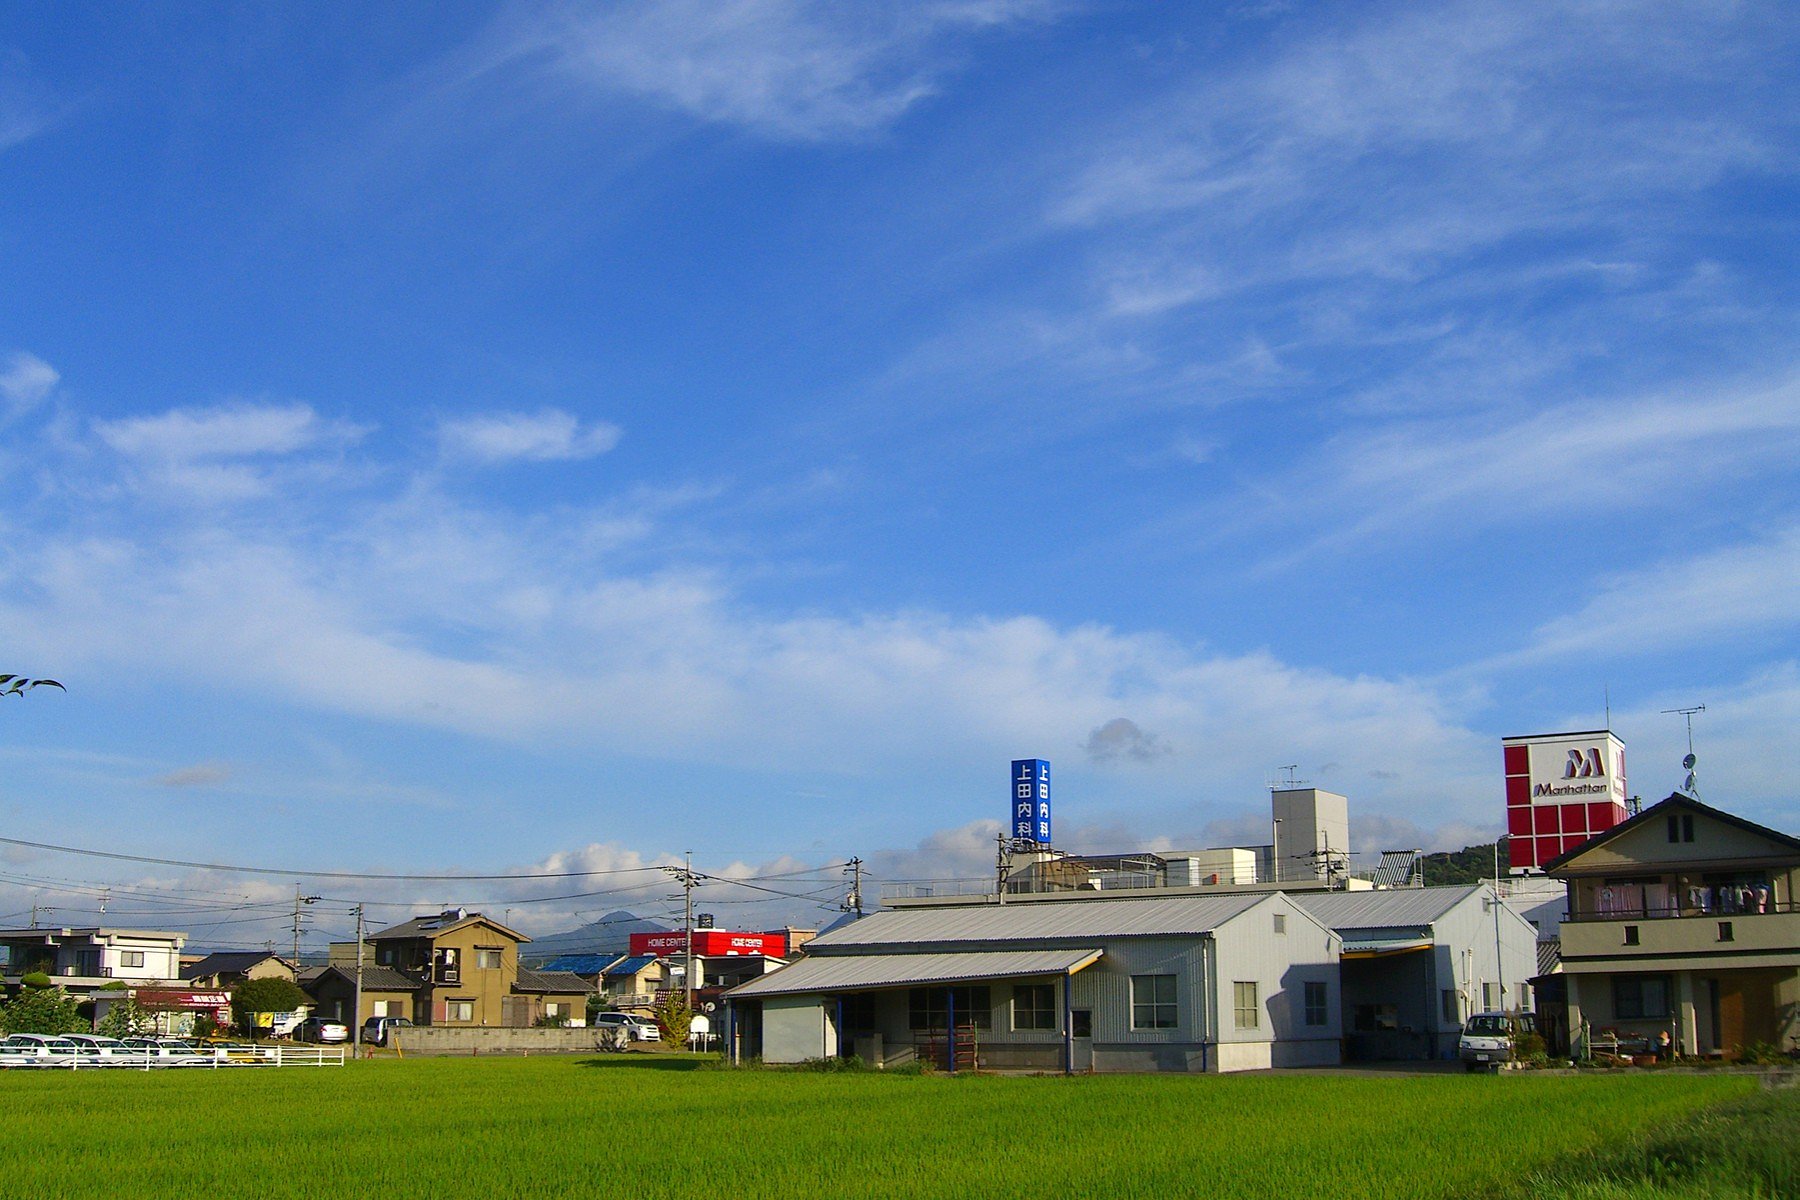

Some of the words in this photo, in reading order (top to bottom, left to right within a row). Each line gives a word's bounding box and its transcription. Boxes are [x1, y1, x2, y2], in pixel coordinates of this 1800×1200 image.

[1534, 783, 1607, 798] Manhattan
[1017, 764, 1032, 837] 上田内科
[1039, 764, 1049, 838] 上田内科
[648, 938, 666, 947] HOME
[666, 938, 690, 947] CENTE
[731, 937, 745, 947] HOME
